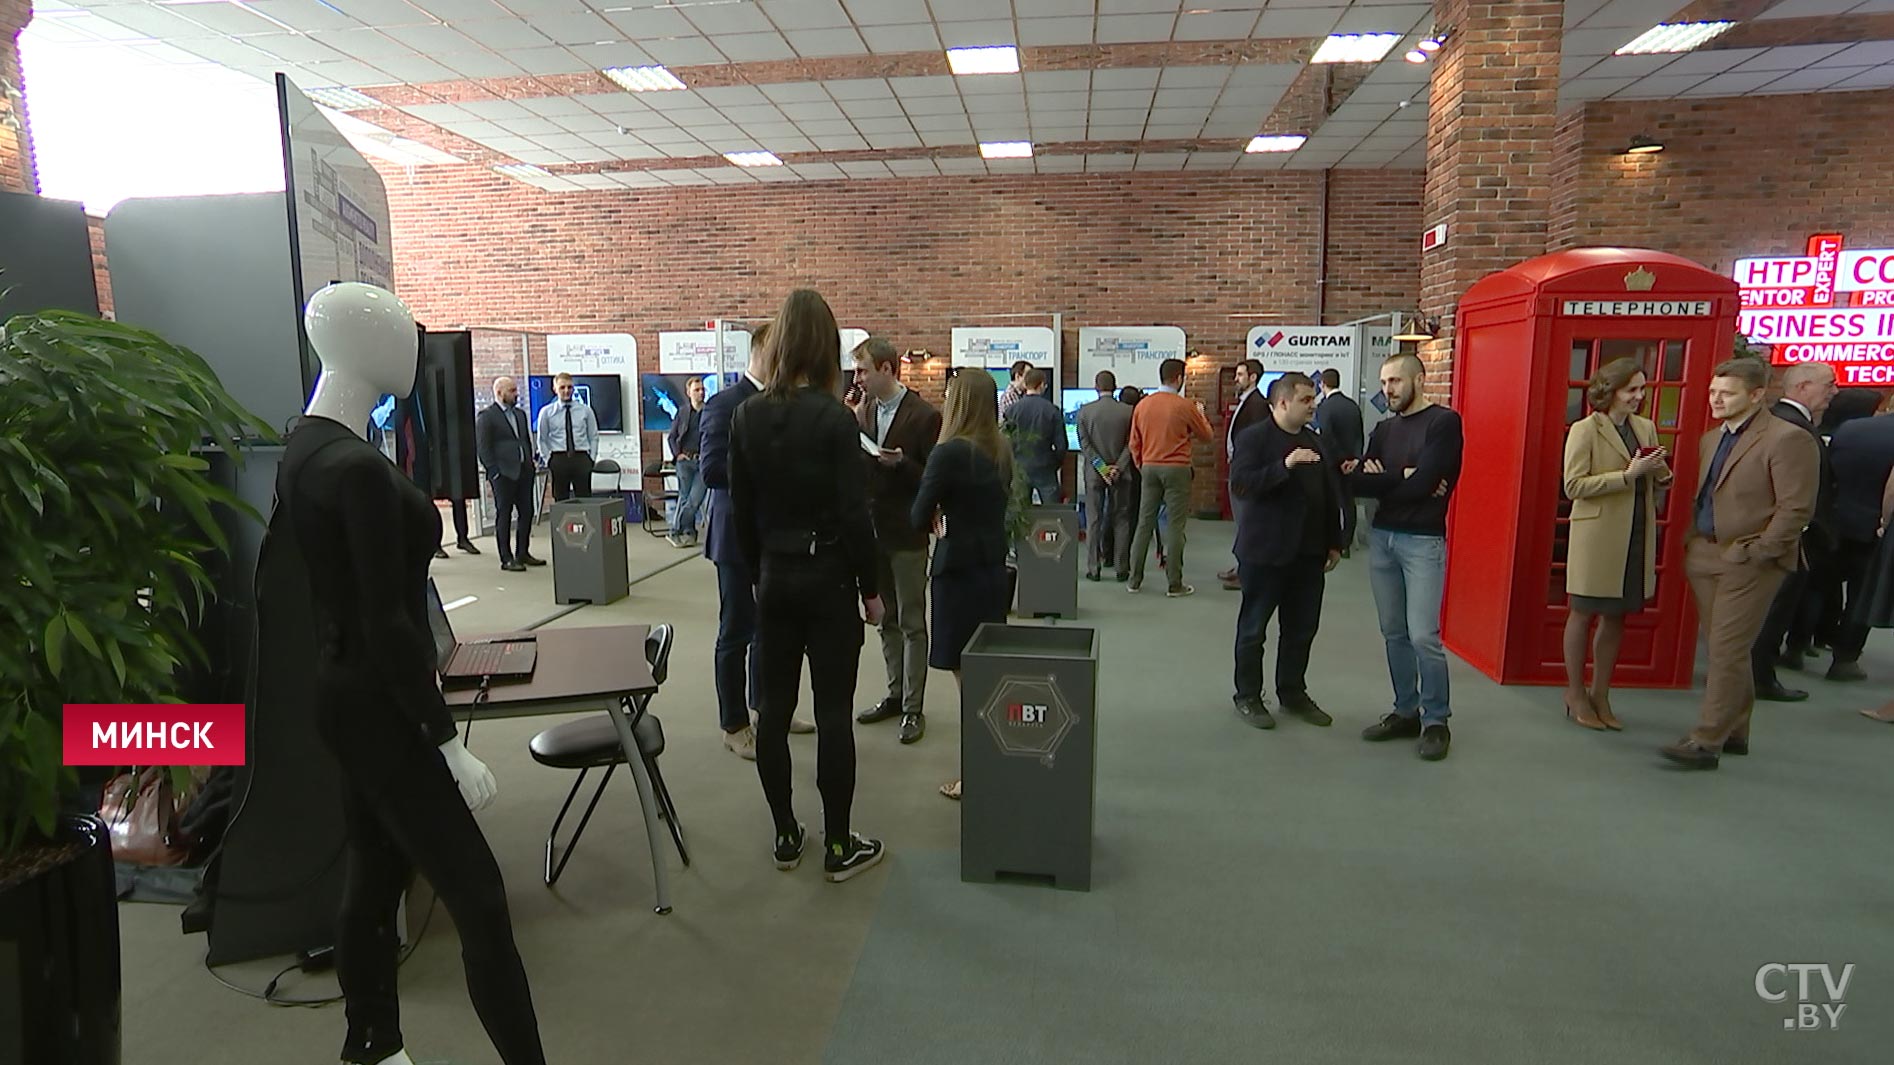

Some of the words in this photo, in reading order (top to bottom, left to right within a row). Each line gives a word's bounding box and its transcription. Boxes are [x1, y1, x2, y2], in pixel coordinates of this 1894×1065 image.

[1748, 260, 1812, 284] HTP
[1813, 240, 1837, 303] EXPERT
[1569, 302, 1706, 316] TELEPHONE
[1288, 335, 1351, 347] GURTAM
[601, 356, 626, 365] ОПТИКА
[1008, 351, 1048, 361] ТРАНСПОРТ
[1136, 350, 1177, 361] ТРАНСПОРТ
[1008, 704, 1048, 722] ПВТ
